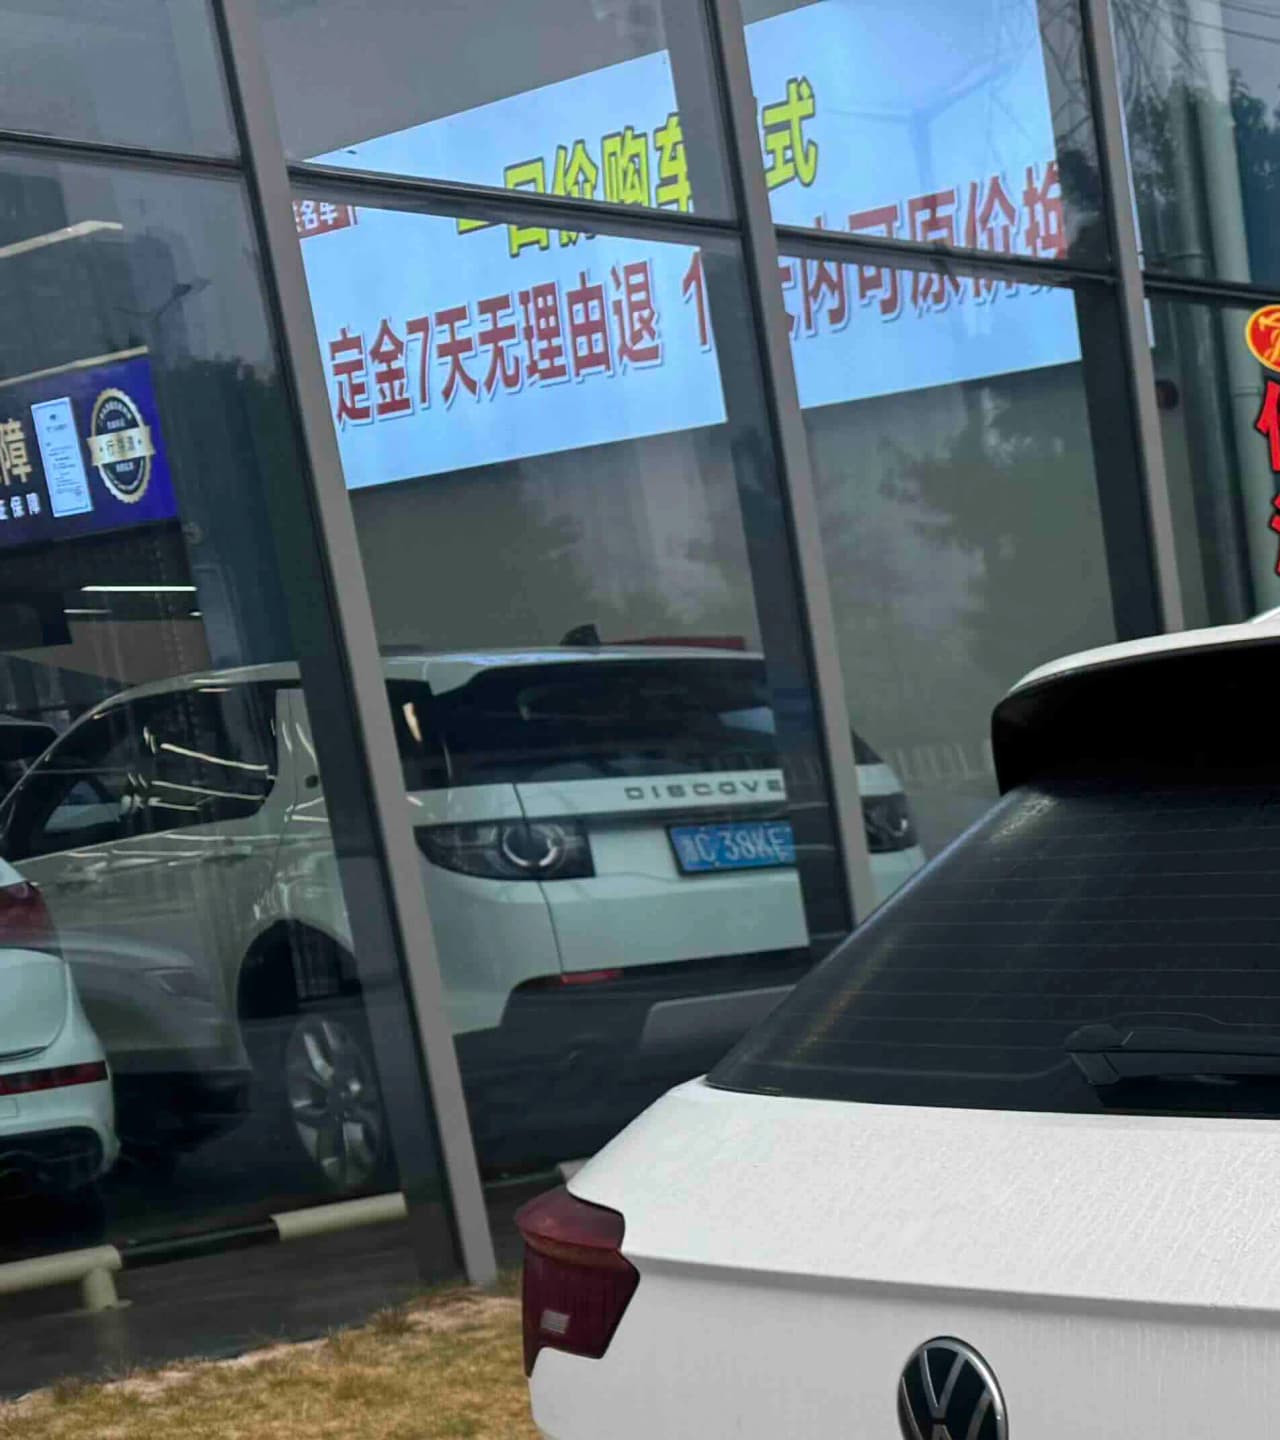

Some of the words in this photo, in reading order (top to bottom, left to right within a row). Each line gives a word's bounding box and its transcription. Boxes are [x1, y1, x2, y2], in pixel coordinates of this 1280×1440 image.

[328, 260, 661, 426] 定金7天无理由退
